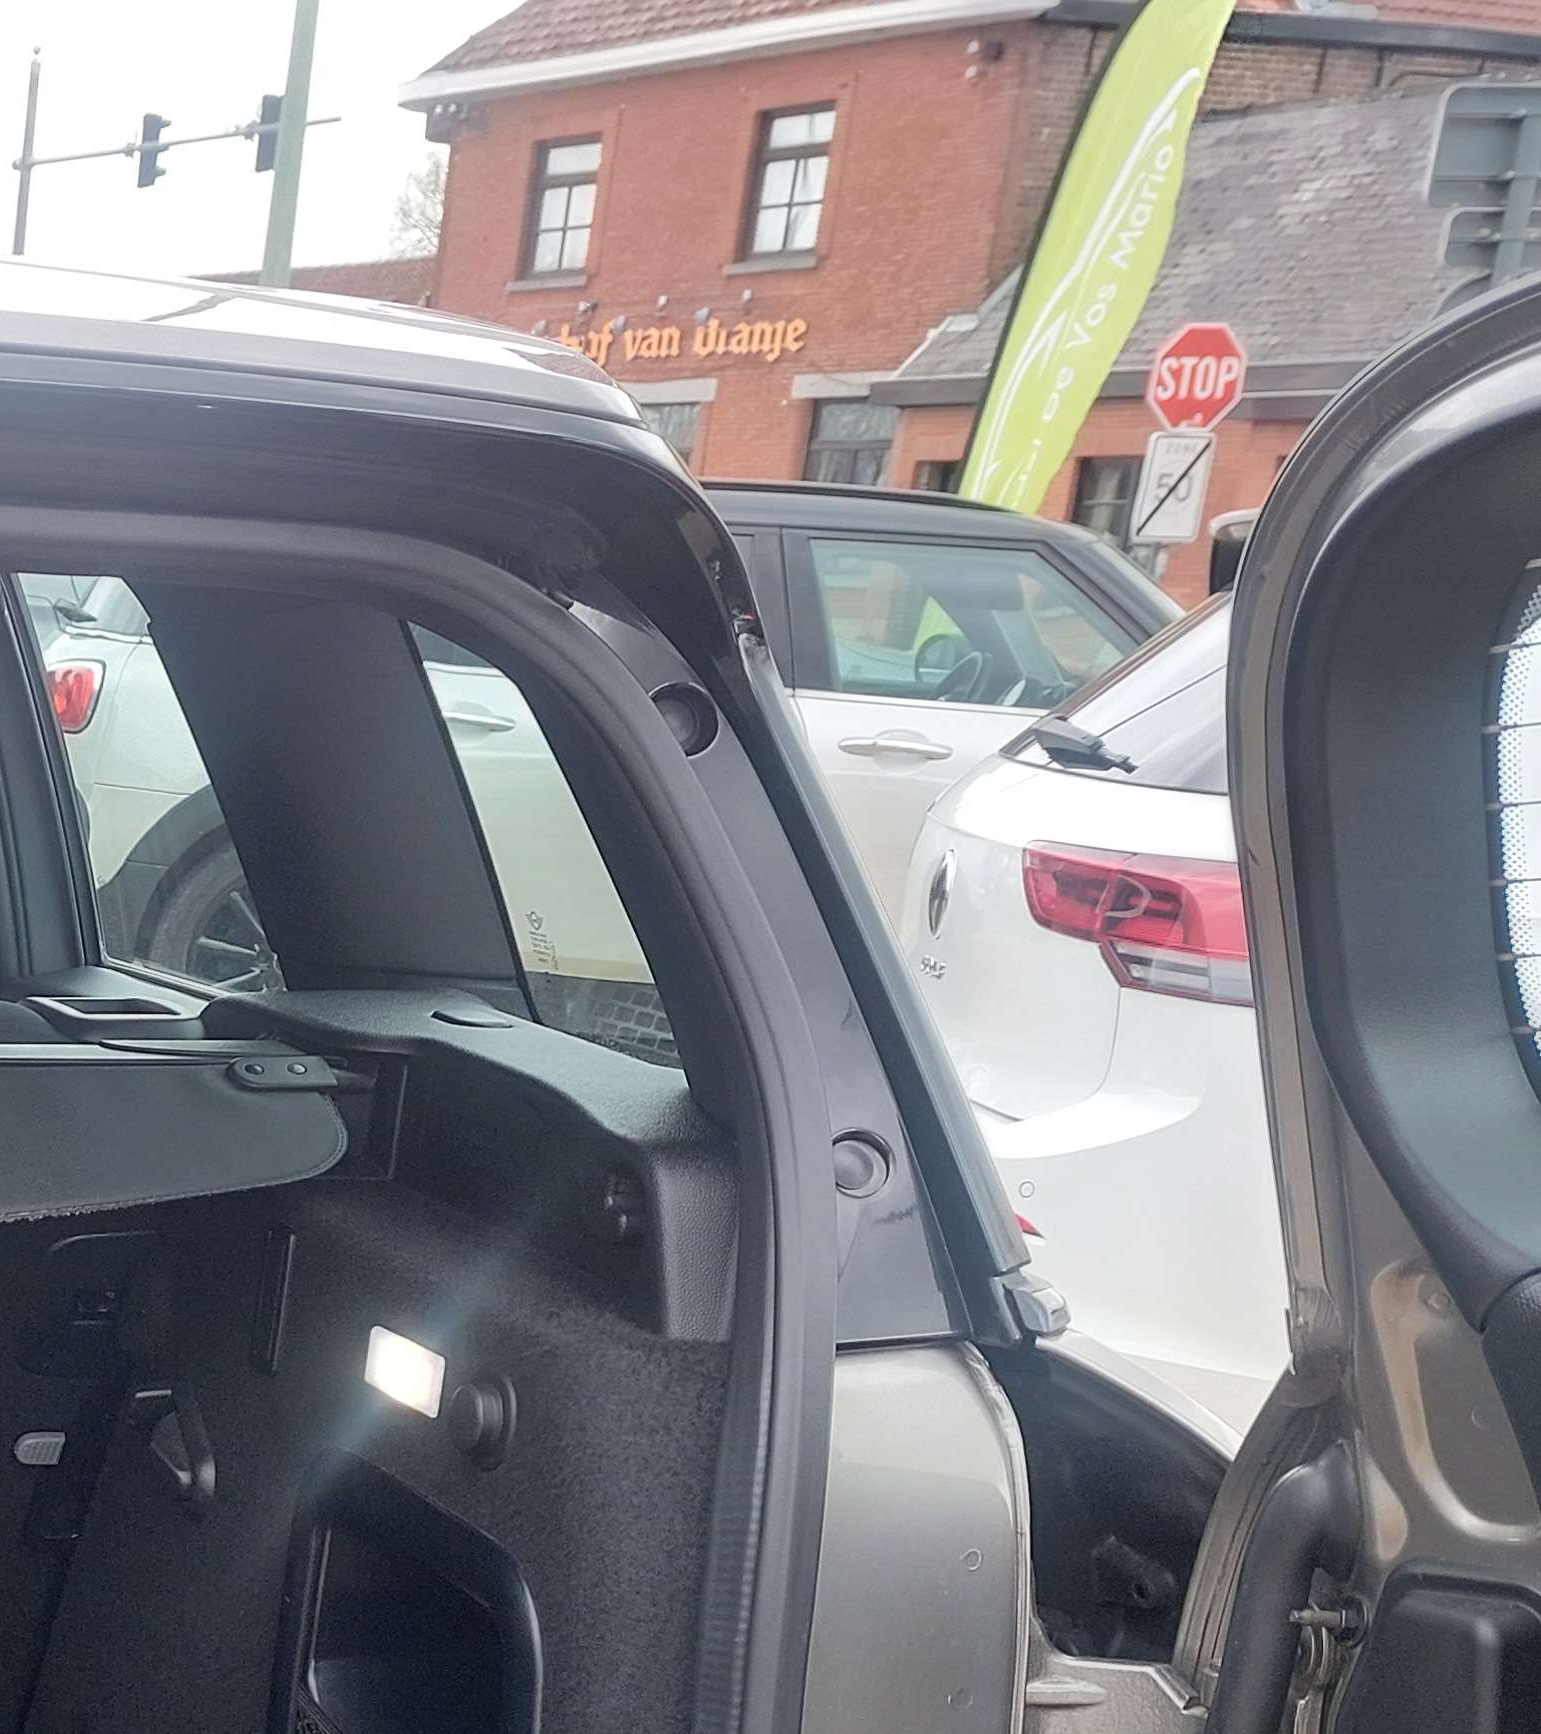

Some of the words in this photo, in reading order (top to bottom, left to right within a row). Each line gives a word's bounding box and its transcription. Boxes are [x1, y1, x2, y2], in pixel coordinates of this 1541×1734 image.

[1066, 282, 1117, 351] Vos
[1108, 144, 1174, 270] Mario
[623, 325, 681, 361] van
[1156, 354, 1240, 401] STOP
[1155, 472, 1192, 503] 50
